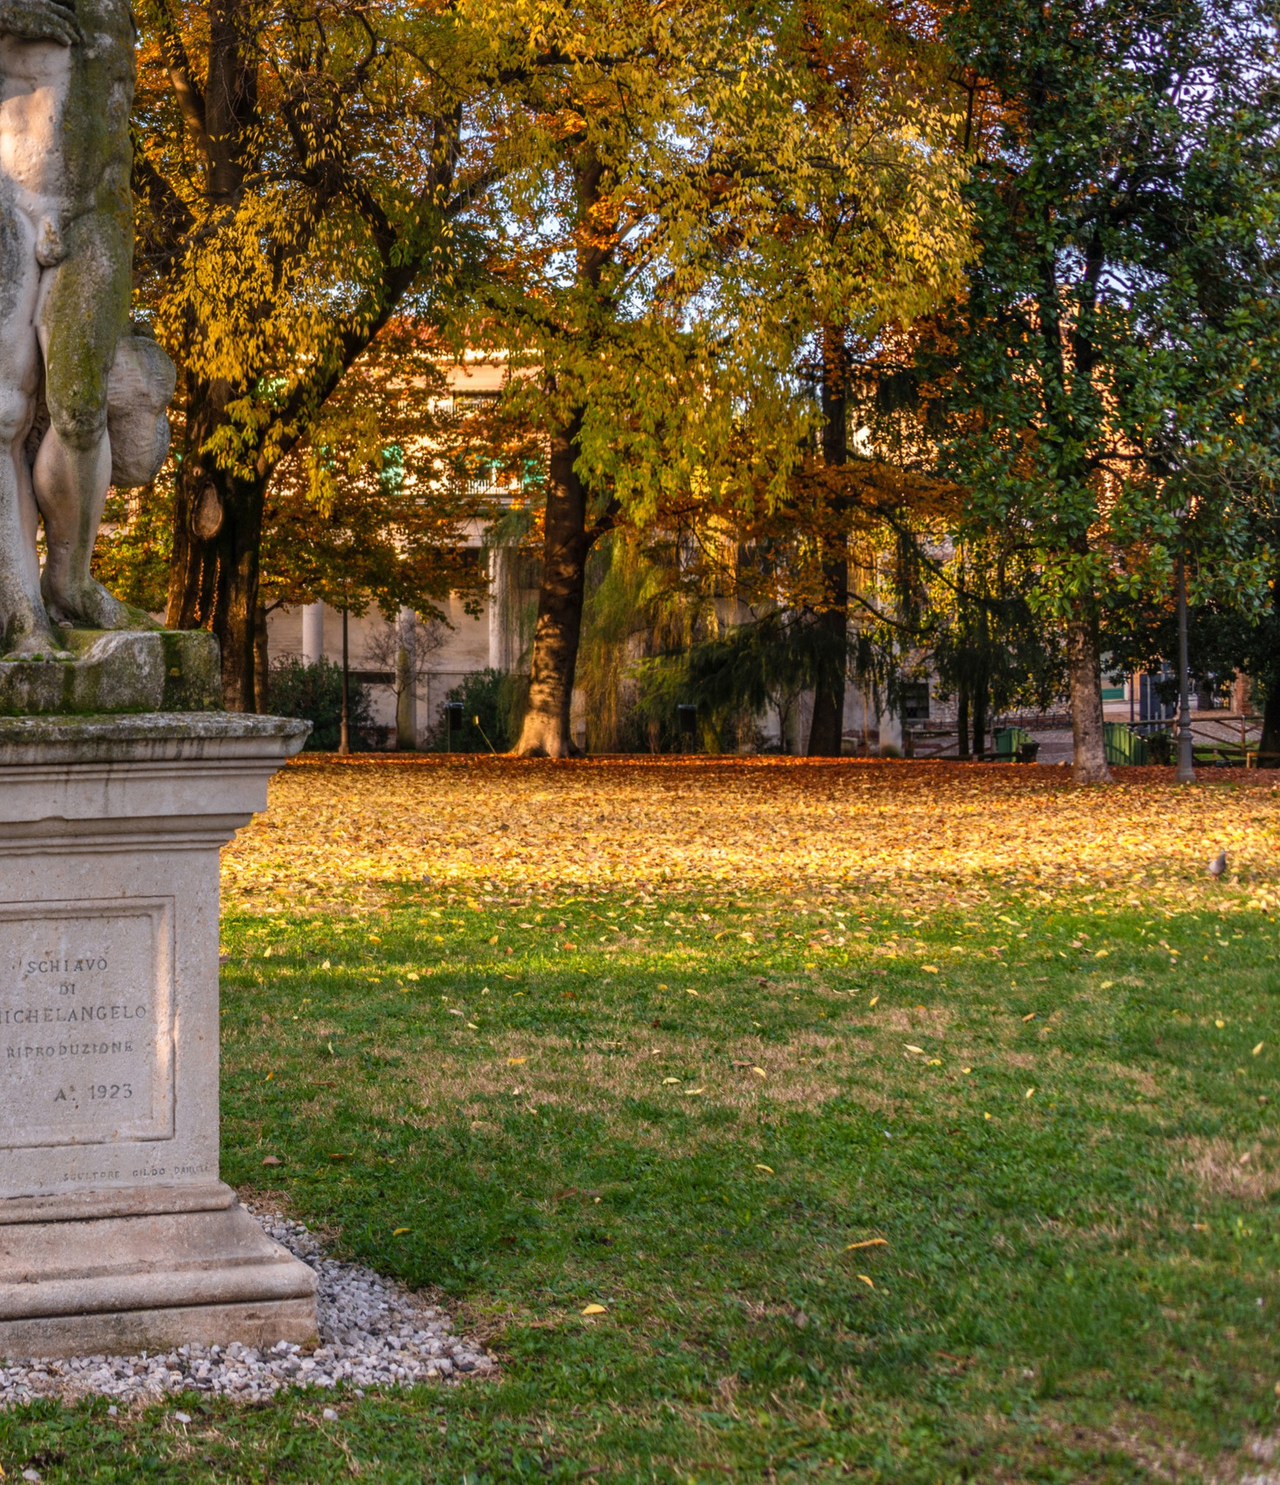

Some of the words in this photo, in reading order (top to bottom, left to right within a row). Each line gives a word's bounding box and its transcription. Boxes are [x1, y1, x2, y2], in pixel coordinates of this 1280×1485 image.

[27, 958, 108, 974] SCHIAVO
[59, 983, 76, 995] DI
[7, 1042, 134, 1058] RIPRODUZIONE
[88, 1083, 133, 1100] 1923
[63, 1171, 120, 1181] SCULTORE
[132, 1168, 166, 1177] GILDO
